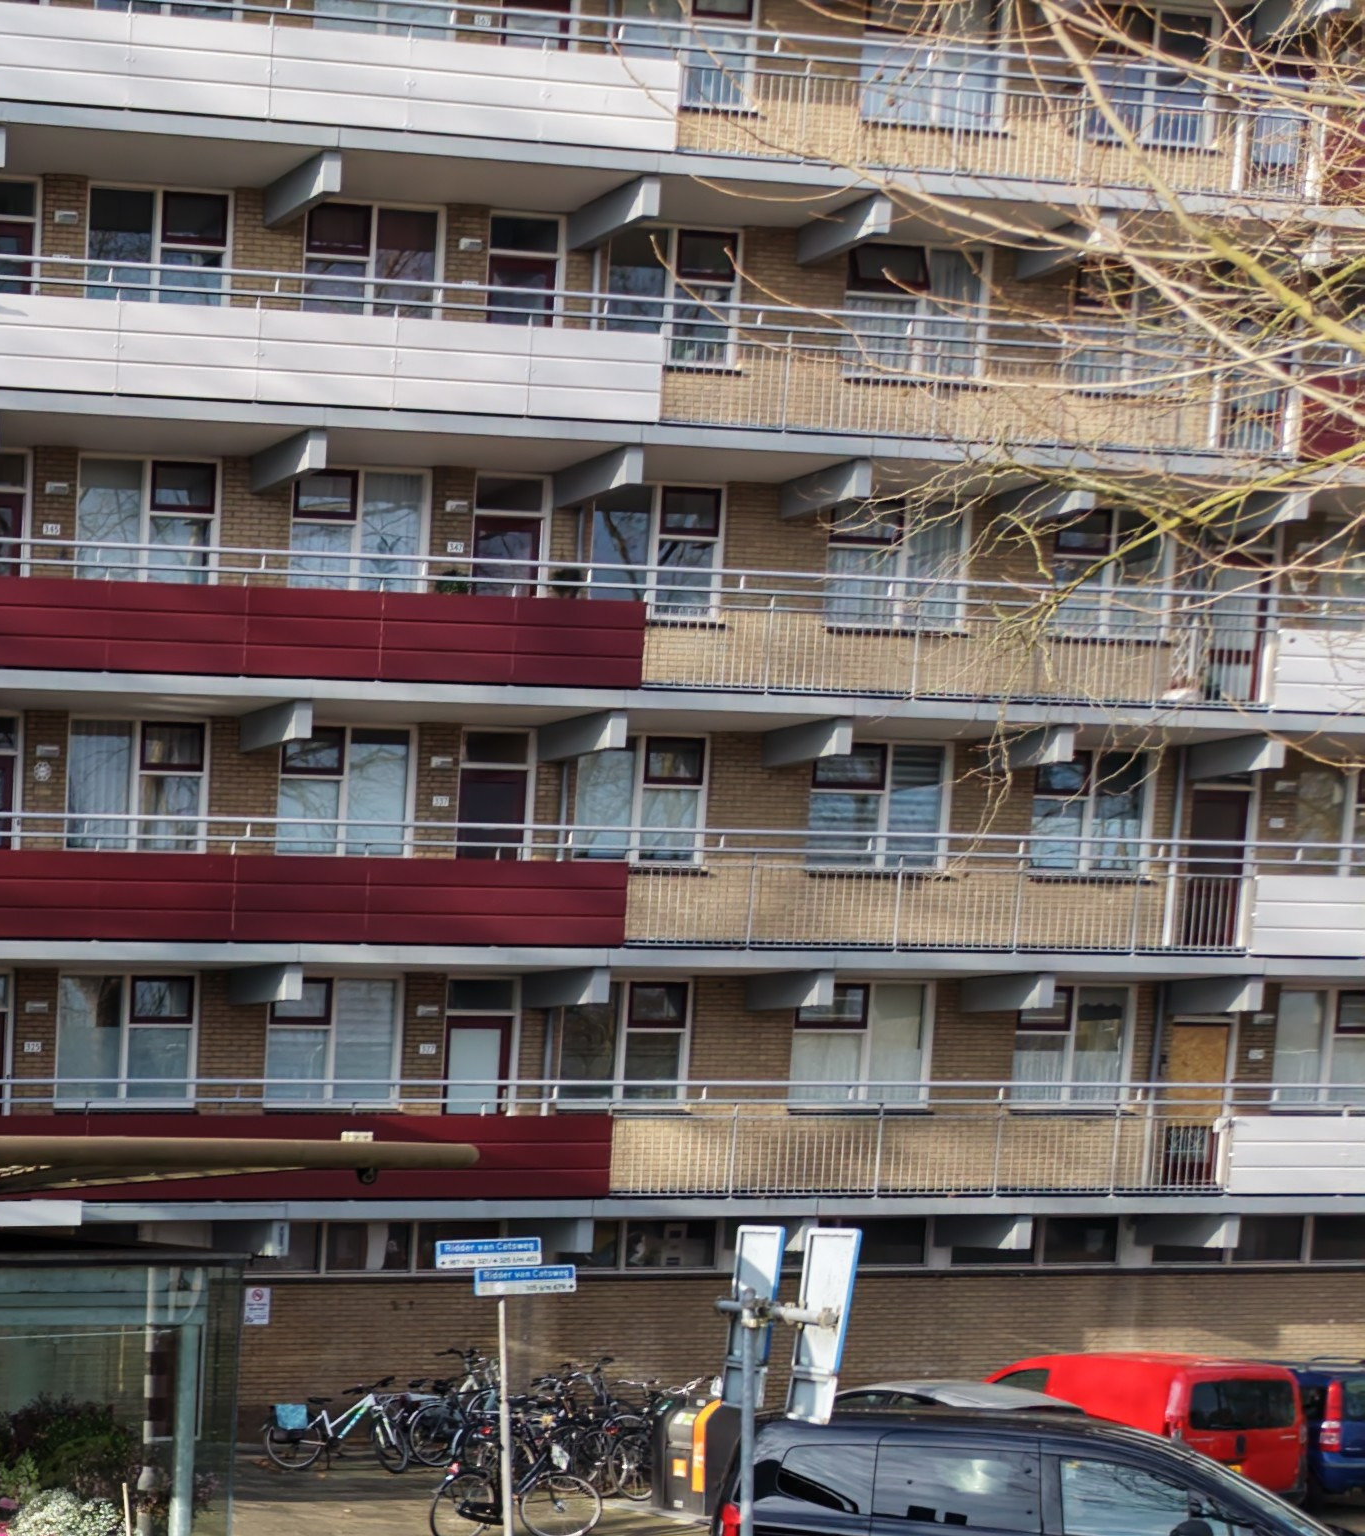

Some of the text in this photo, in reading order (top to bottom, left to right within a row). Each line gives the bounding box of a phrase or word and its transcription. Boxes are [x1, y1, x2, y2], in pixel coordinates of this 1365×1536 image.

[444, 1243, 474, 1252] Ridder
[496, 1241, 534, 1251] Catsweg
[483, 1270, 511, 1279] Ridder
[532, 1269, 569, 1279] Catsweg
